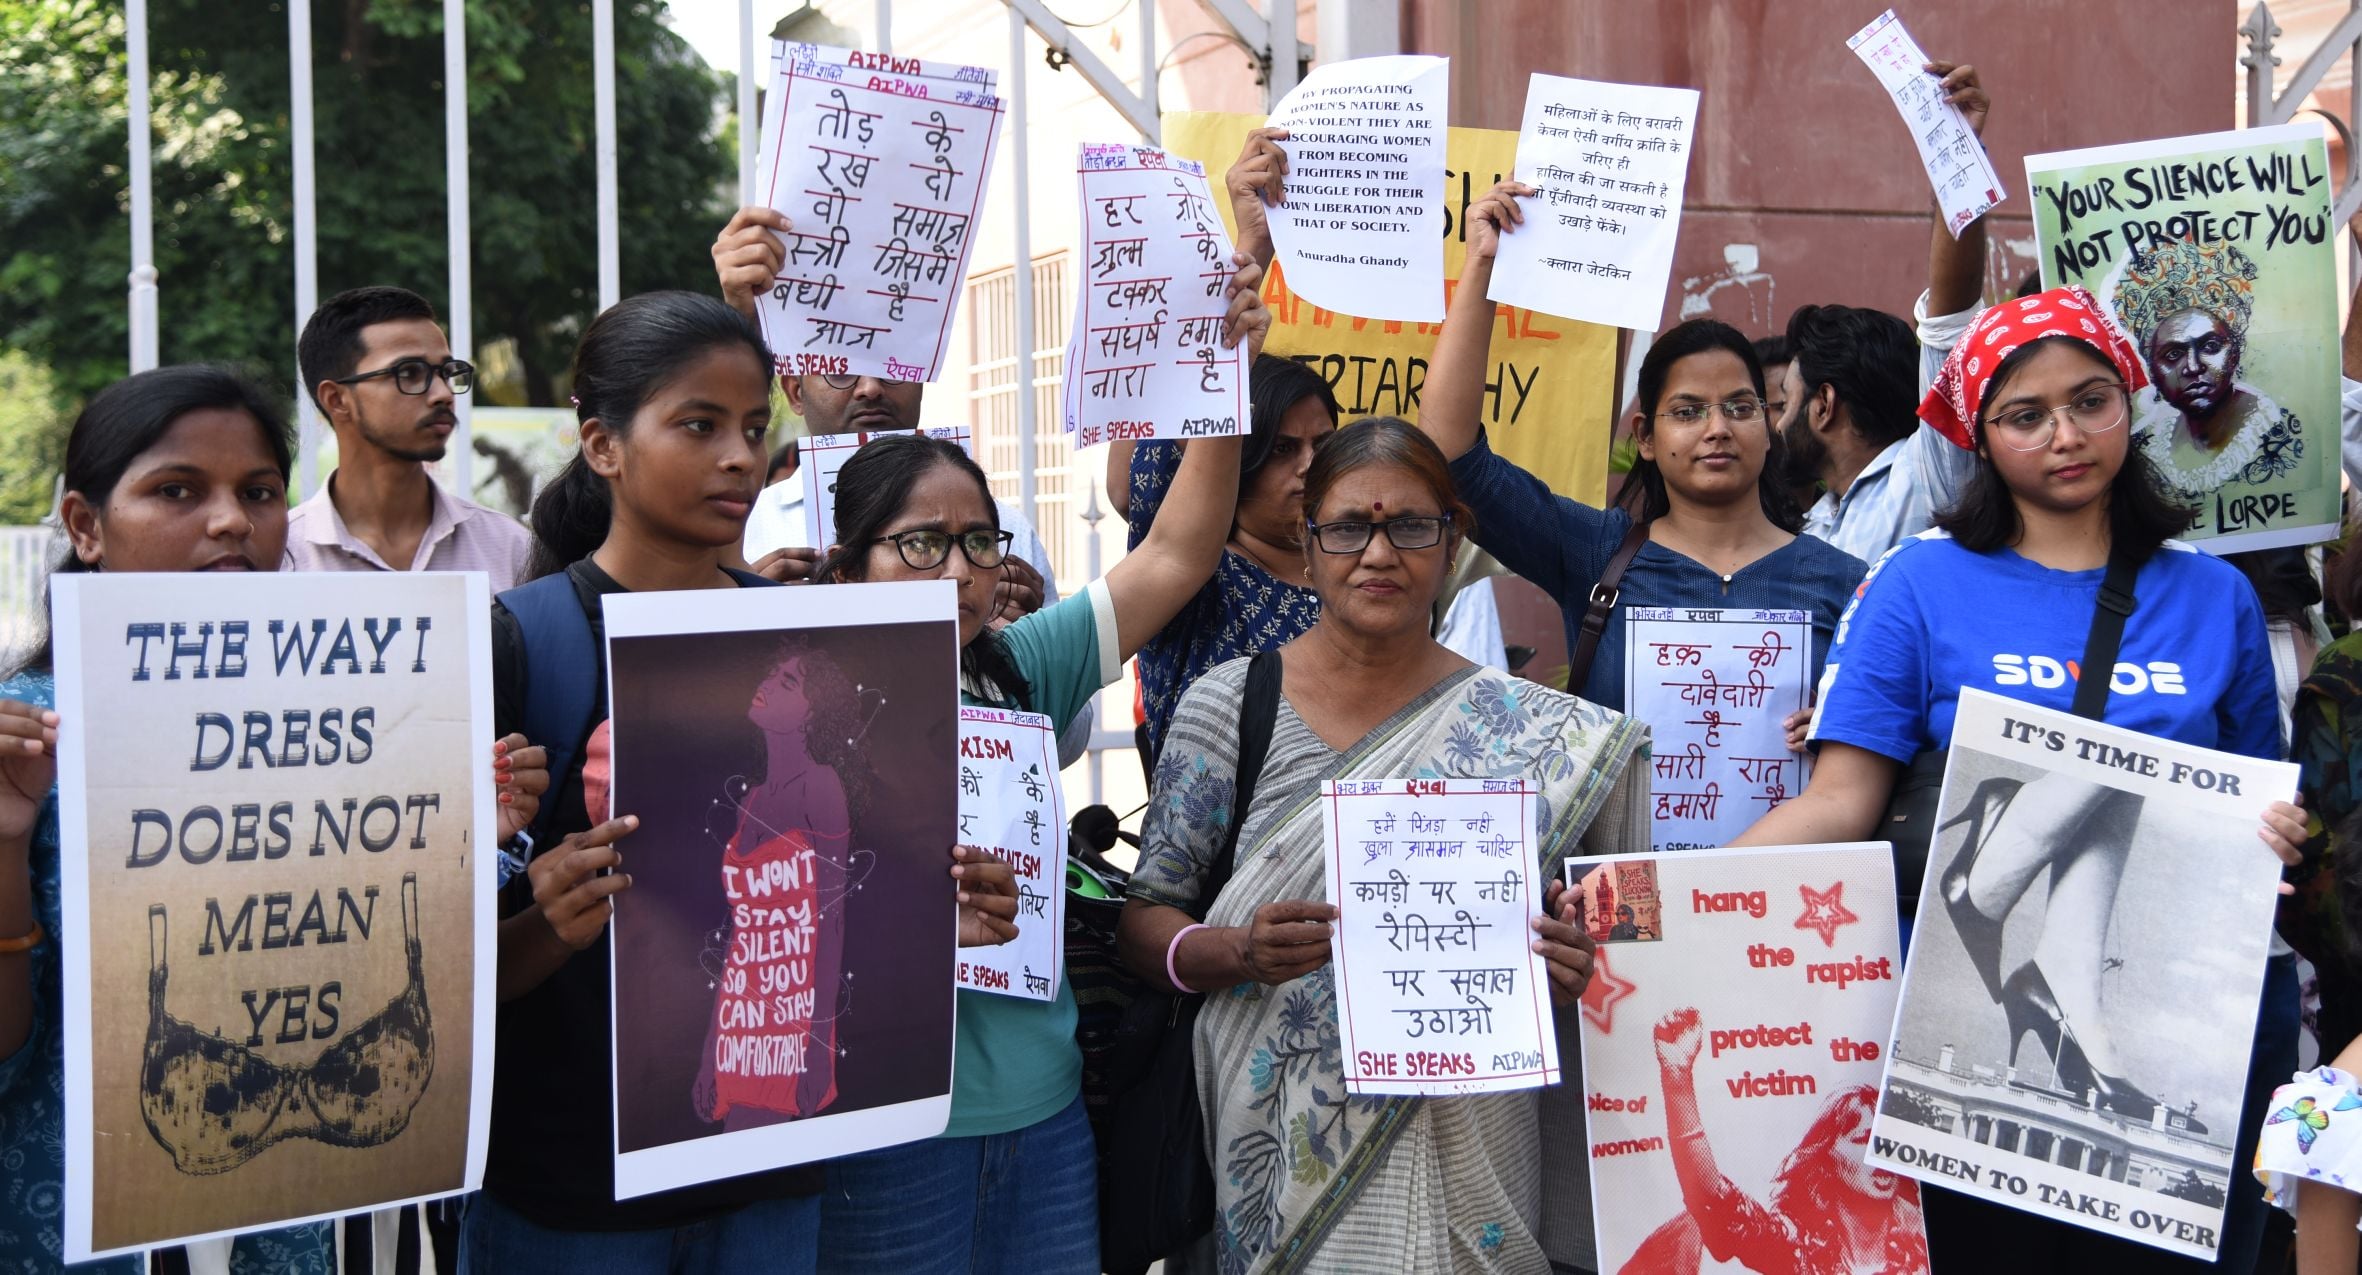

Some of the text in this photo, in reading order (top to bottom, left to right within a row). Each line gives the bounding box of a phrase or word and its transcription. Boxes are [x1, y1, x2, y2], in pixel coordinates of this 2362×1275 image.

[848, 50, 921, 76] AIPWA
[867, 76, 928, 98] AIPWA
[1302, 85, 1412, 99] BY PROPAGATING
[816, 89, 964, 152] तोड़ के
[1280, 117, 1432, 129] NON-VIOLENT THEY ARE
[1290, 101, 1423, 114] WOMEN'S NATURE AS
[1544, 103, 1683, 131] महिलाओं के लिए बराबरी
[1383, 136, 1430, 146] WOMEN
[1537, 123, 1682, 154] केवल ऐसी वर्गीय क्रांति के
[1299, 151, 1408, 162] FROM BECOMING
[1582, 151, 1631, 170] जरिए ही
[809, 145, 963, 201] रख दो
[1297, 168, 1408, 180] FIGHTERS IN THE
[1536, 165, 1668, 199] हासिल की जा सकती है
[2125, 156, 2243, 209] SILENCE
[2247, 150, 2324, 196] WILL
[804, 187, 862, 225] वो
[1283, 184, 1424, 198] STRUGGLE FOR THEIR
[1549, 187, 1667, 219] पूँजीवादी व्यवस्था को
[1095, 195, 1146, 227] हर
[1281, 201, 1423, 216] OWN LIBERATION AND
[1559, 214, 1593, 232] उखाड़े
[1293, 218, 1410, 232] THAT OF SOCIETY.
[788, 226, 957, 285] स्त्री जिसमें
[1180, 222, 1220, 263] के
[1297, 249, 1408, 268] Anuradha Ghandy
[2054, 230, 2112, 283] NOT
[2122, 209, 2261, 255] PROTECT
[1094, 261, 1236, 310] टक्कर में
[1587, 261, 1632, 280] जेटकिन
[867, 282, 938, 321] है
[805, 318, 891, 349] आज
[1091, 310, 1168, 358] संघर्ष
[774, 352, 848, 376] SHE SPEAKS
[1084, 347, 1236, 399] नारा है
[1081, 421, 1154, 447] SHE SPEAKS
[1182, 417, 1236, 435] AIPWA
[2216, 492, 2298, 535] LORDE
[125, 615, 432, 682] THE WAY I
[1733, 631, 1792, 667] की
[1661, 669, 1774, 708] दावेदारी
[961, 708, 996, 720] AIPWA
[1685, 711, 1742, 747] है
[190, 706, 375, 772] DRESS
[961, 736, 1014, 762] XISM
[1652, 743, 1793, 784] सारी रात
[2001, 717, 2242, 797] IT'S TIME FOR
[1019, 772, 1045, 802] के
[1651, 782, 1723, 820] हमारी
[125, 793, 441, 868] DOES NOT
[1024, 810, 1046, 846] है
[1367, 811, 1397, 834] हमें
[1460, 811, 1494, 834] नहीं
[1359, 834, 1522, 865] खुला आसमान चाहिए
[723, 849, 816, 898] I WON'T
[1349, 869, 1523, 909] कपड़ों पर नहीं
[1627, 868, 1641, 878] SHE
[735, 898, 811, 928] STAY
[1019, 884, 1049, 919] लिए
[1691, 888, 1767, 919] hang
[198, 884, 379, 957] MEAN
[1375, 910, 1492, 952] रेपिस्टों
[732, 925, 815, 966] SILENT
[723, 959, 808, 995] SO YOU
[974, 965, 1009, 990] SPEAKS
[1747, 943, 1891, 988] the rapist
[1383, 968, 1517, 996] पर सवाल
[240, 981, 342, 1048] YES
[719, 987, 815, 1030] CAN STAY
[1392, 995, 1493, 1037] उठाओ
[715, 1032, 808, 1079] COMFORTABLE
[1710, 1021, 1879, 1062] protect the
[1358, 1051, 1475, 1077] SHE SPEAKS
[1492, 1051, 1544, 1071] AIPWA
[1726, 1069, 1816, 1099] victim
[1588, 1092, 1647, 1113] oice of
[1592, 1137, 1663, 1158] women
[1872, 1134, 2217, 1249] WOMEN TO TAKE OVER
